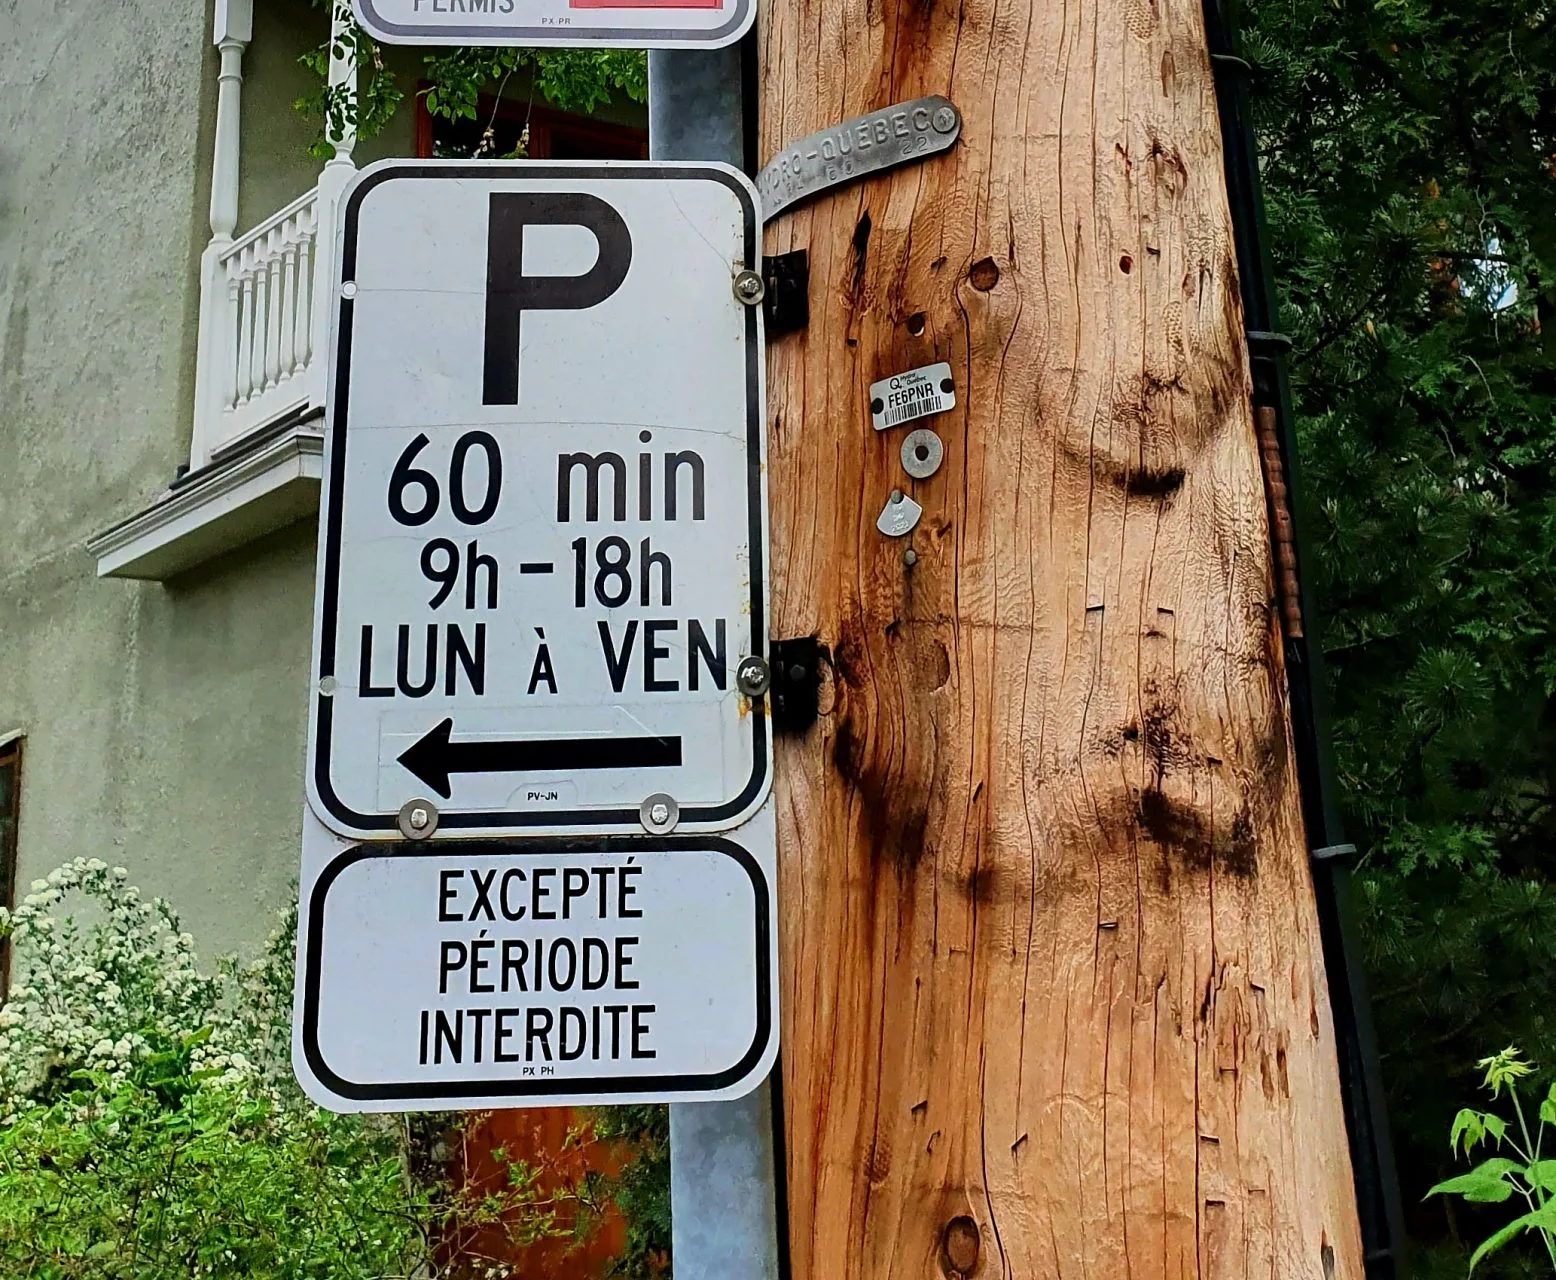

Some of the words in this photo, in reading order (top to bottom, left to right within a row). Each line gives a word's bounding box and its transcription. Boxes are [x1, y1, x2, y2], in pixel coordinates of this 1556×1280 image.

[482, 192, 632, 405] P
[888, 382, 934, 408] FE6PNR
[387, 430, 503, 527] 60
[558, 430, 705, 522] min
[420, 537, 498, 610] 9h
[572, 536, 672, 607] 18h
[359, 623, 485, 697] LUN
[527, 627, 557, 695] À
[598, 619, 727, 692] VEN
[527, 792, 558, 801] PV-JN
[438, 857, 642, 921] EXCEPTÉ
[439, 929, 639, 994] PÉRIODE
[419, 1005, 656, 1064] INTERDITE
[541, 1066, 554, 1075] PH
